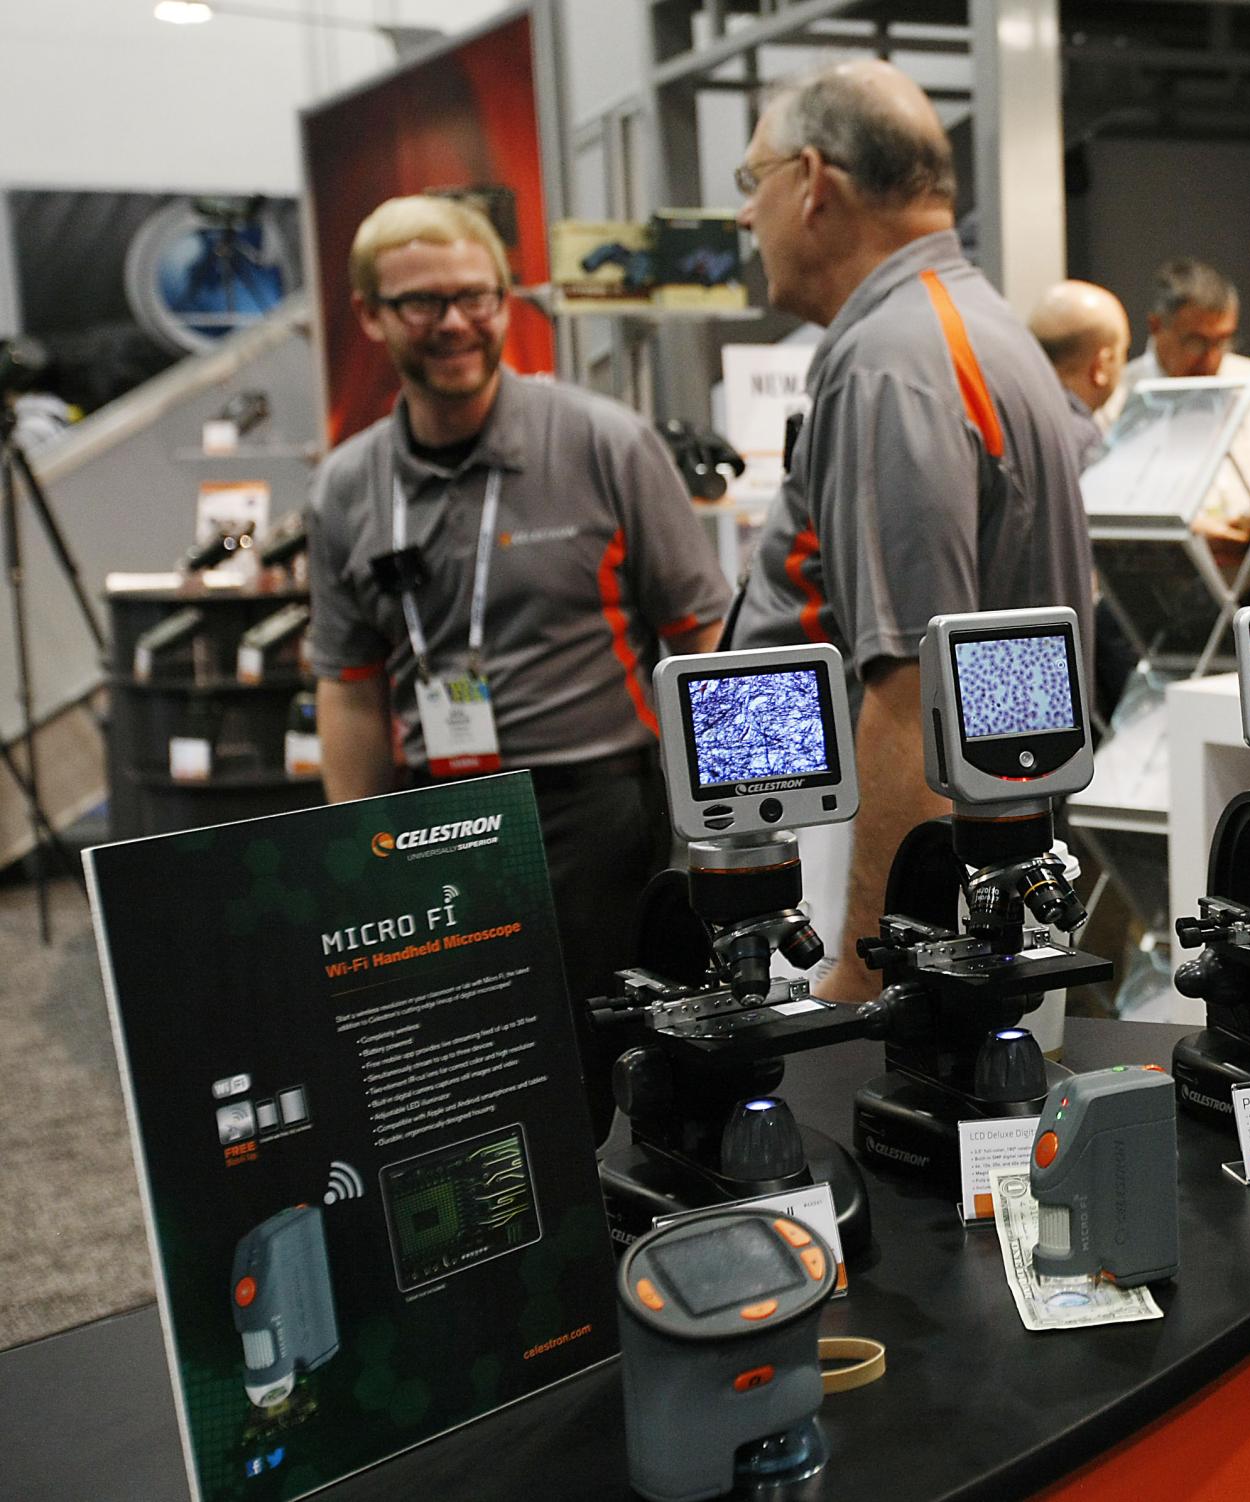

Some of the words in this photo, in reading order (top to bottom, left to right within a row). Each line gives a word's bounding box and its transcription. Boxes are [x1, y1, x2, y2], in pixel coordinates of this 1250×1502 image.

[747, 779, 803, 793] CELESTRON
[396, 814, 503, 849] CELESTRON
[321, 914, 415, 955] MICRO
[325, 956, 369, 978] Wi-Fi
[373, 939, 440, 967] Handheld
[444, 922, 522, 949] Microscope
[1189, 1090, 1234, 1113] CELESTRON
[969, 1132, 985, 1140] LCD
[987, 1129, 1013, 1139] Deluxe
[1015, 1128, 1033, 1138] Digit
[224, 1140, 257, 1158] FREE
[875, 1142, 926, 1168] CELESTRON
[523, 1323, 593, 1360] celestron.com
